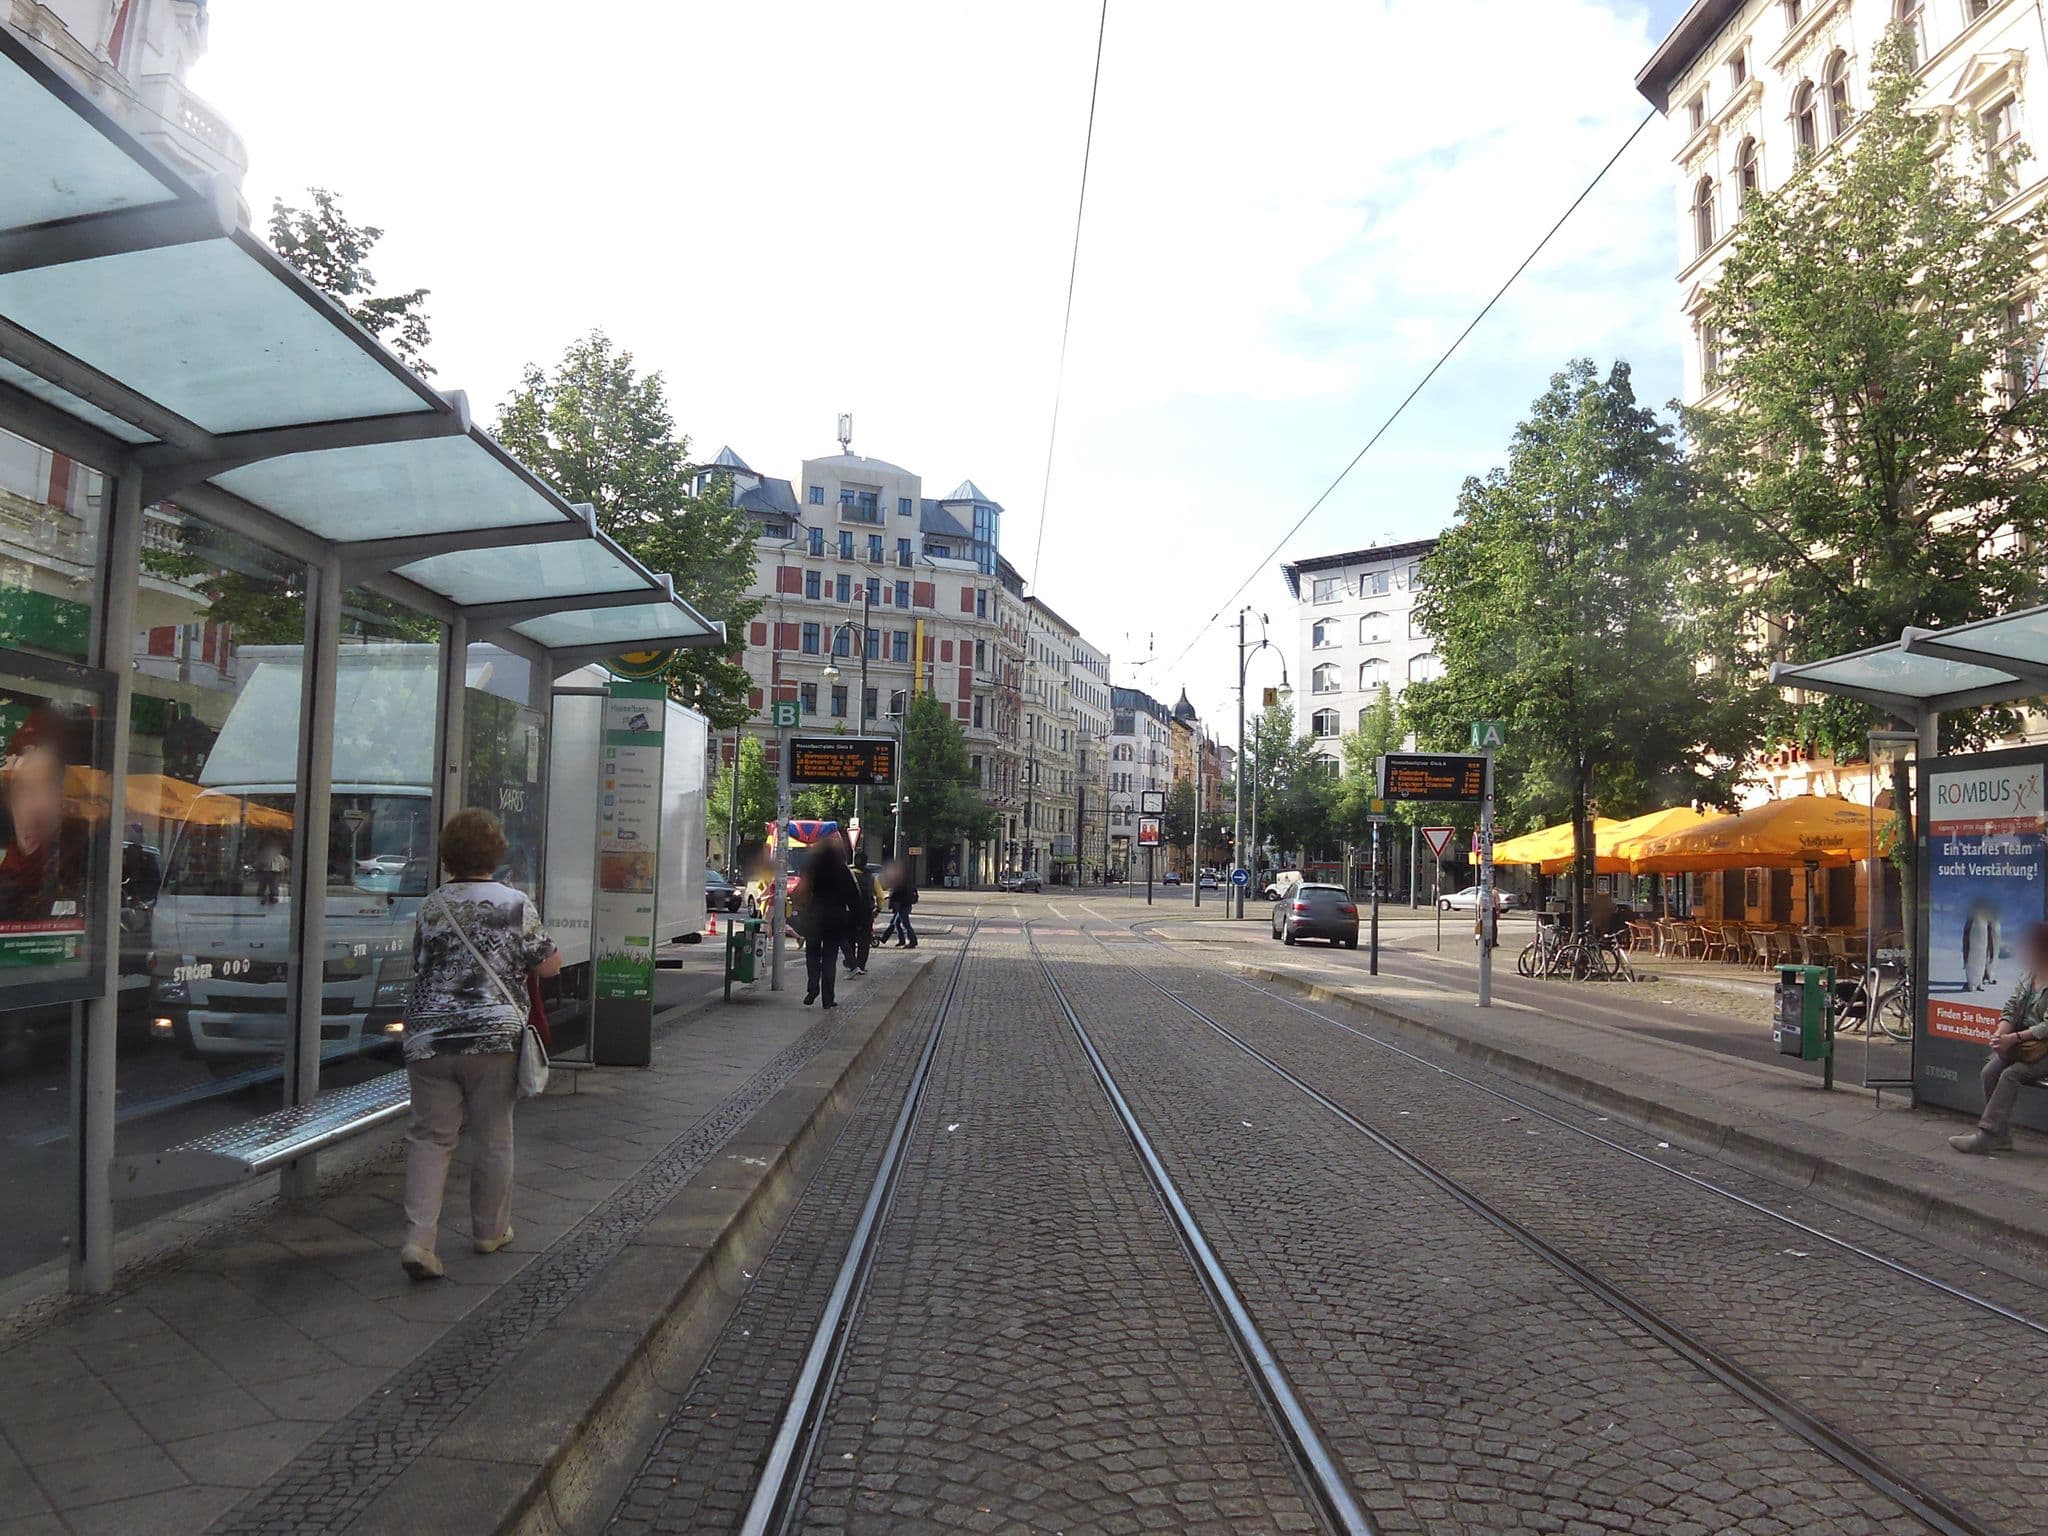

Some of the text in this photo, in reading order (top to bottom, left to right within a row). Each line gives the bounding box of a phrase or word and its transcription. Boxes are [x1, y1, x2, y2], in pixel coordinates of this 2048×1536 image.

[779, 705, 796, 725] B
[1472, 726, 1479, 746] A
[1482, 726, 1501, 746] A
[1938, 779, 2010, 804] ROMBUS
[1943, 842, 2033, 856] Ein starkes Team
[1938, 862, 2038, 880] sucht Verstärkung!
[1937, 1007, 1996, 1026] Finden Sie Ihren
[1936, 1023, 1994, 1040] www.zeitarbeit-
